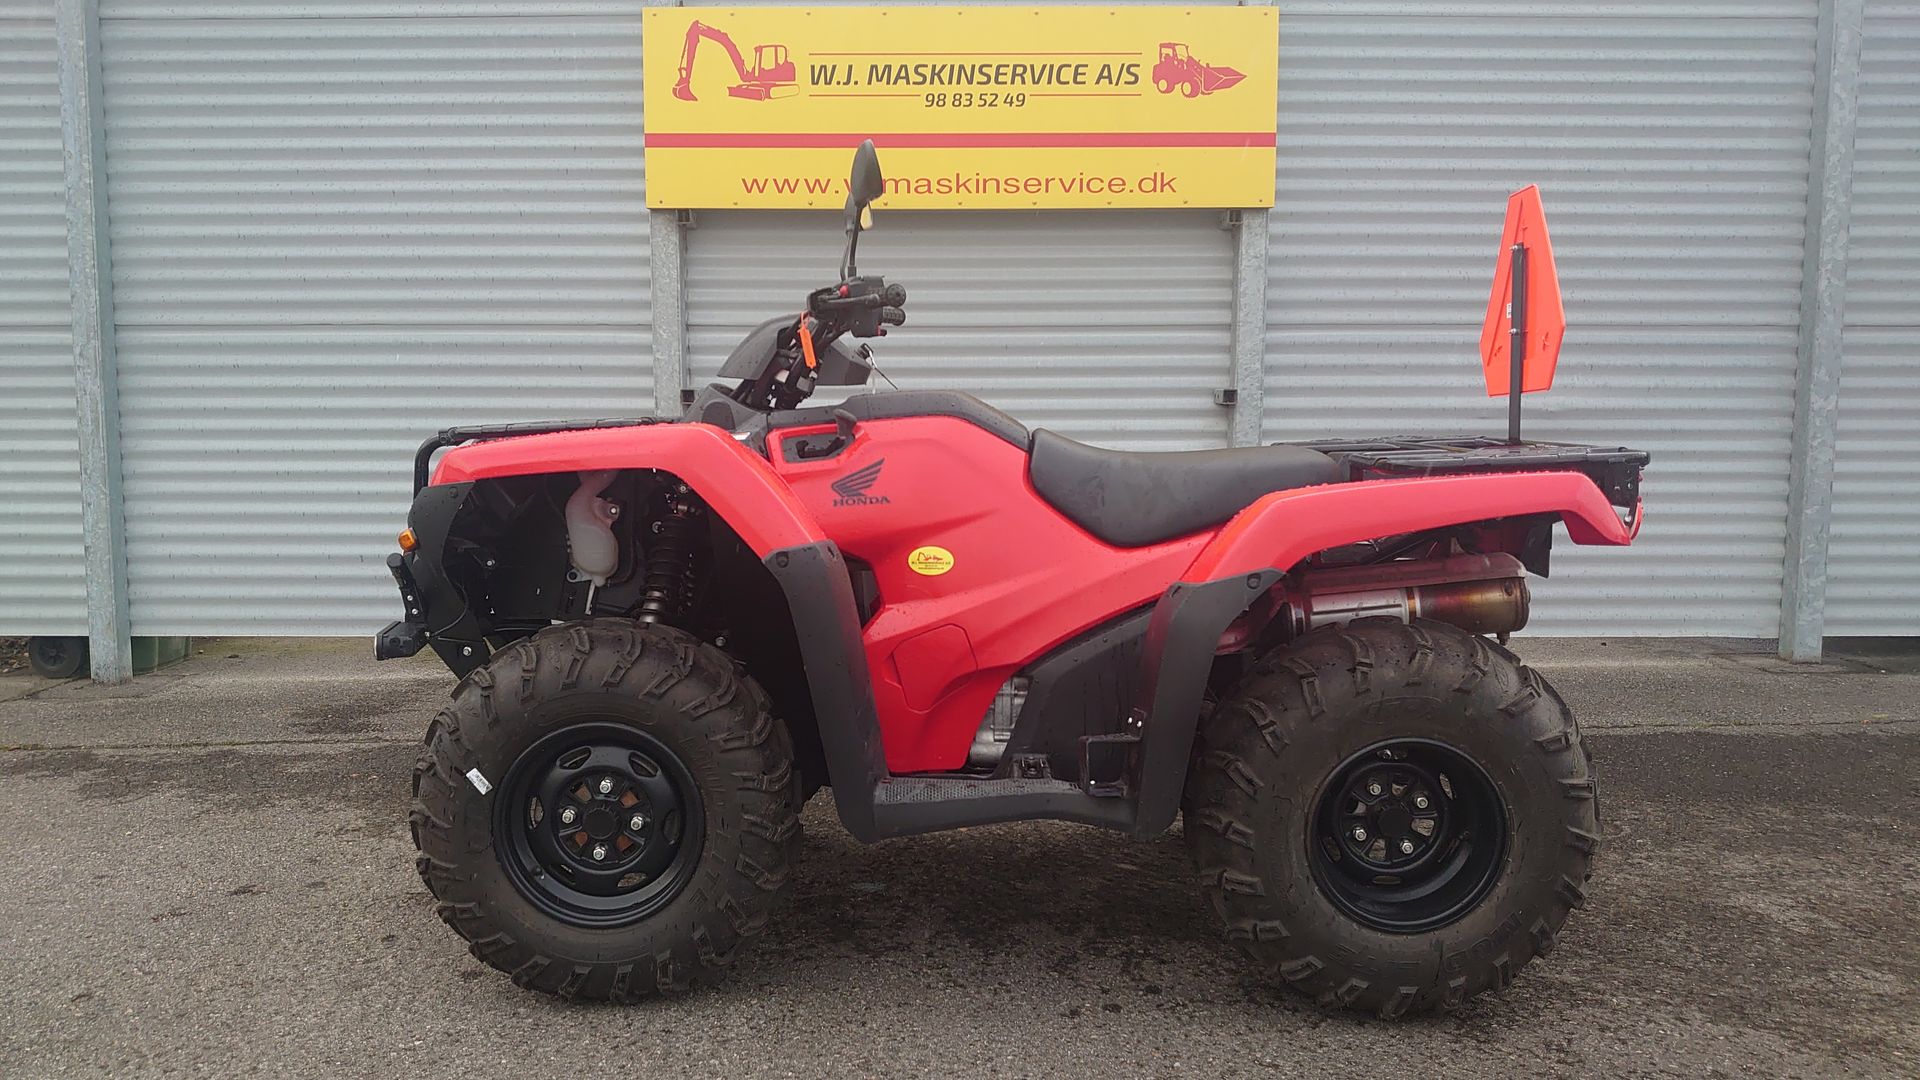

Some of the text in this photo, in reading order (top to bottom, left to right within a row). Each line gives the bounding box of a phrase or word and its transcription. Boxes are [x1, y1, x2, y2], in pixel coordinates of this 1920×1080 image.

[810, 63, 1141, 87] W.J. MASKINSERVICE A/S
[924, 93, 1026, 107] 98 83 52 49
[832, 496, 891, 507] HONDA
